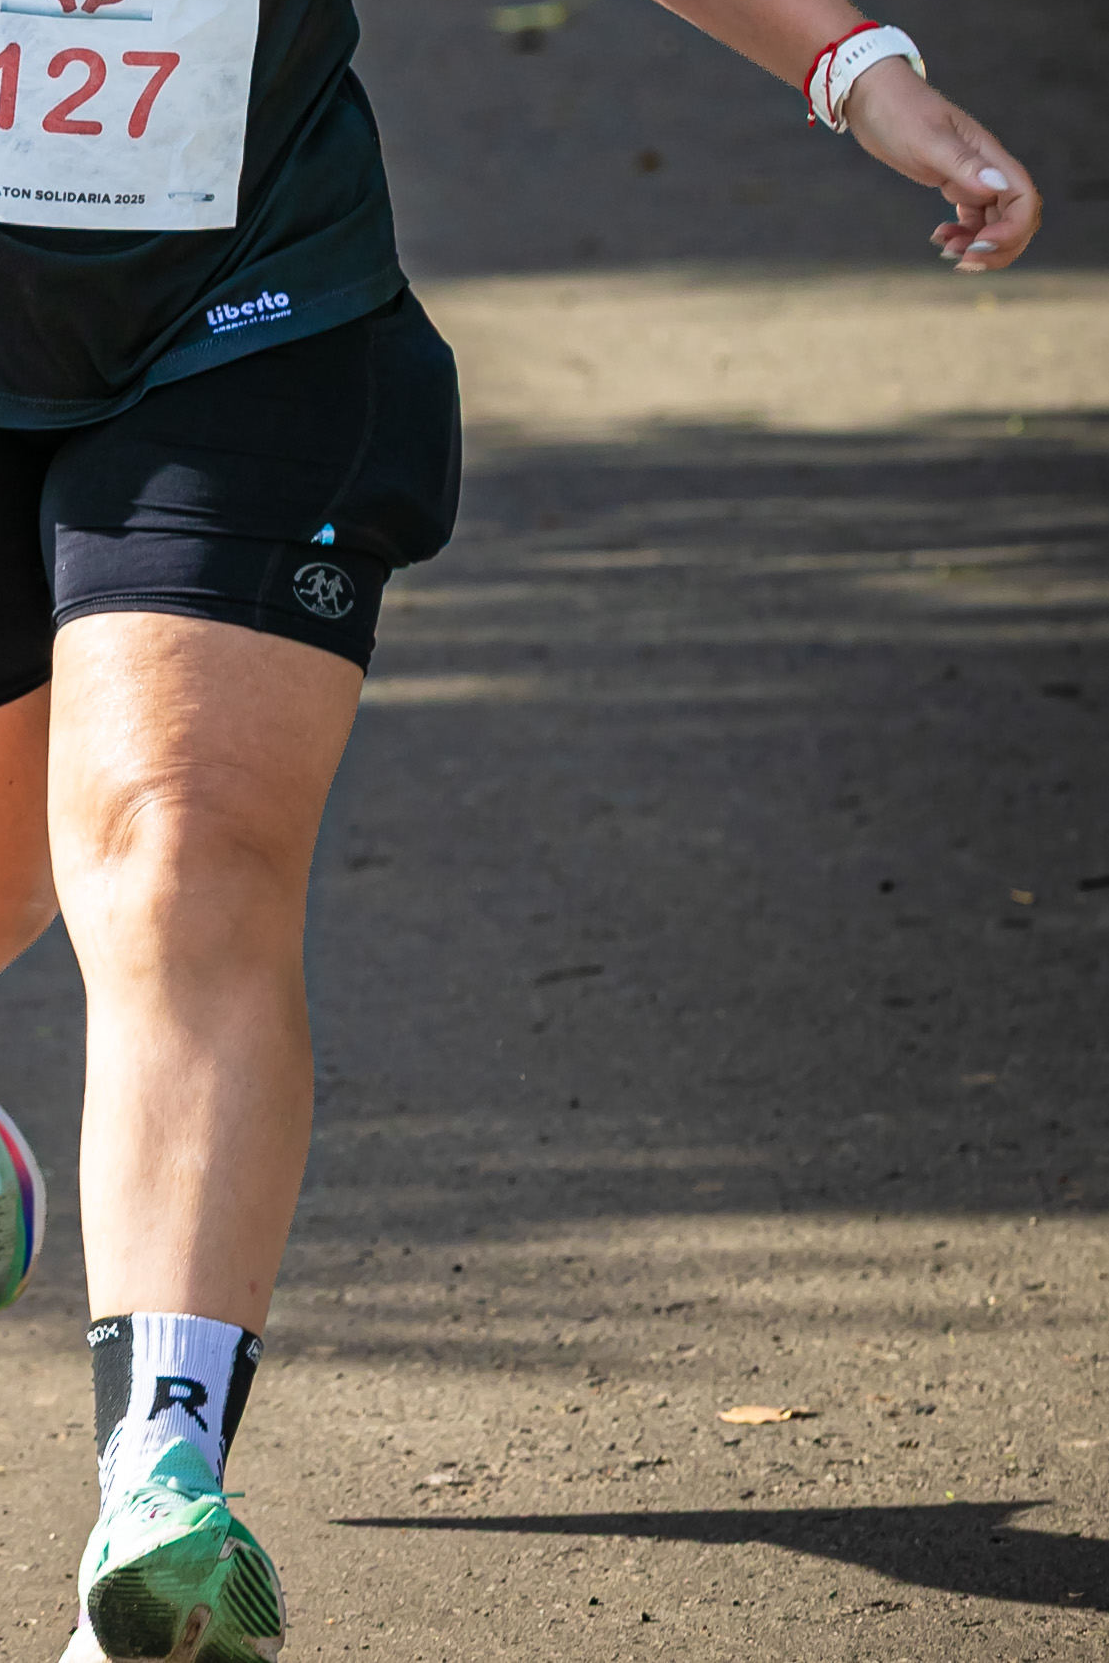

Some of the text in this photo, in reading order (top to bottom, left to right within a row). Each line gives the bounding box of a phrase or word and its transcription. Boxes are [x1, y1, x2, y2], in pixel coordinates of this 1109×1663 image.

[34, 190, 111, 205] SOLIDARIA
[114, 194, 146, 205] 2025
[147, 1375, 209, 1433] R
